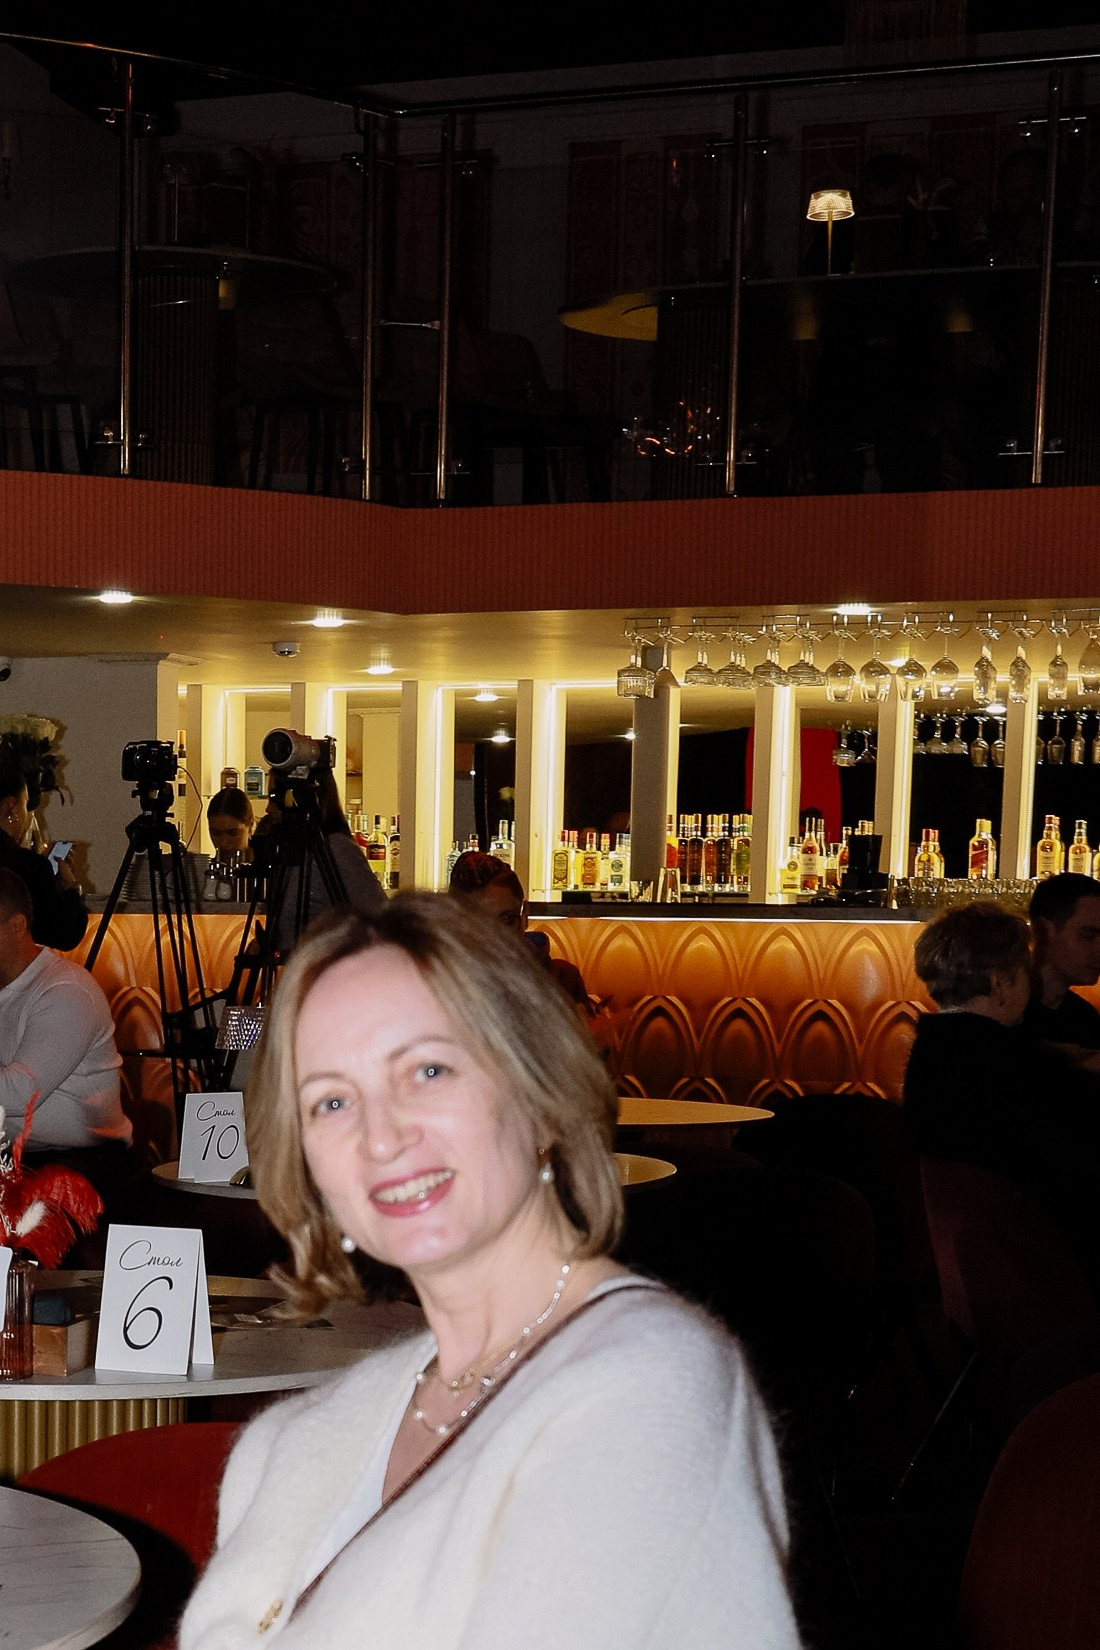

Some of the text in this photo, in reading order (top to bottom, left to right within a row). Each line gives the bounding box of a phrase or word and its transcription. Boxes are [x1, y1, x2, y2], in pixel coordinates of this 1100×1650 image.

[197, 1100, 236, 1121] Стол
[200, 1124, 240, 1161] 10
[119, 1239, 184, 1271] Стол
[122, 1275, 174, 1351] 6
